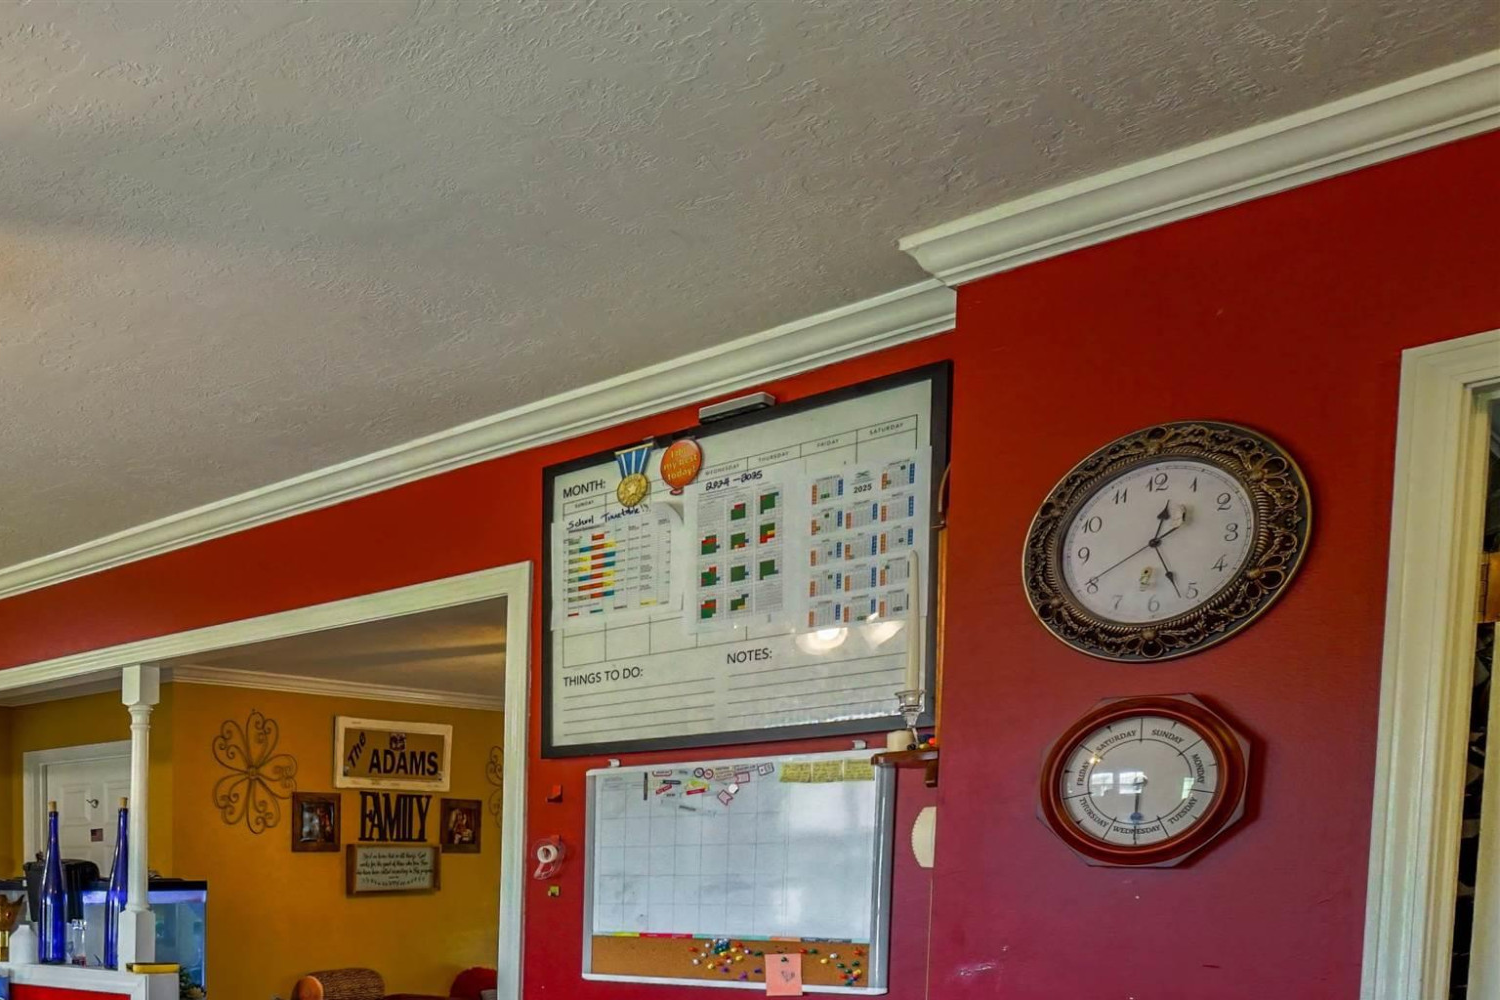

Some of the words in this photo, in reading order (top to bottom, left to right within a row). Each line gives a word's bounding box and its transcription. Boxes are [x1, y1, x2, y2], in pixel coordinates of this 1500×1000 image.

[869, 422, 904, 436] SATURDAY
[816, 438, 840, 448] FRIDAY
[758, 451, 789, 462] THURSDAY
[704, 463, 740, 476] WEDNESDAY
[562, 479, 606, 499] MONTH:
[853, 483, 873, 494] 2025
[1146, 472, 1169, 492] 12
[1189, 477, 1198, 492] 1
[1112, 488, 1128, 504] 11
[1216, 492, 1232, 512] 2
[1081, 516, 1102, 533] 10
[1224, 522, 1239, 541] 3
[1077, 546, 1091, 565] 9
[1211, 553, 1228, 572] 4
[1086, 576, 1099, 595] 8
[1185, 582, 1198, 599] 5
[1112, 595, 1123, 610] 7
[1148, 594, 1160, 612] 6
[726, 647, 773, 664] NOTES:
[563, 671, 602, 687] THINGS
[604, 669, 620, 681] TO
[623, 666, 644, 680] DO:
[1096, 729, 1137, 752] SATURDAY
[1151, 728, 1185, 744] SUNDAY
[368, 748, 439, 776] ADAMS
[1191, 753, 1205, 785] MONDAY
[1077, 760, 1090, 786] FRIDAY
[358, 791, 433, 842] FAMILY
[1079, 797, 1110, 828] THURSDAY
[1167, 797, 1198, 825] TUESDAY
[1113, 824, 1161, 835] WEDNESDAY
